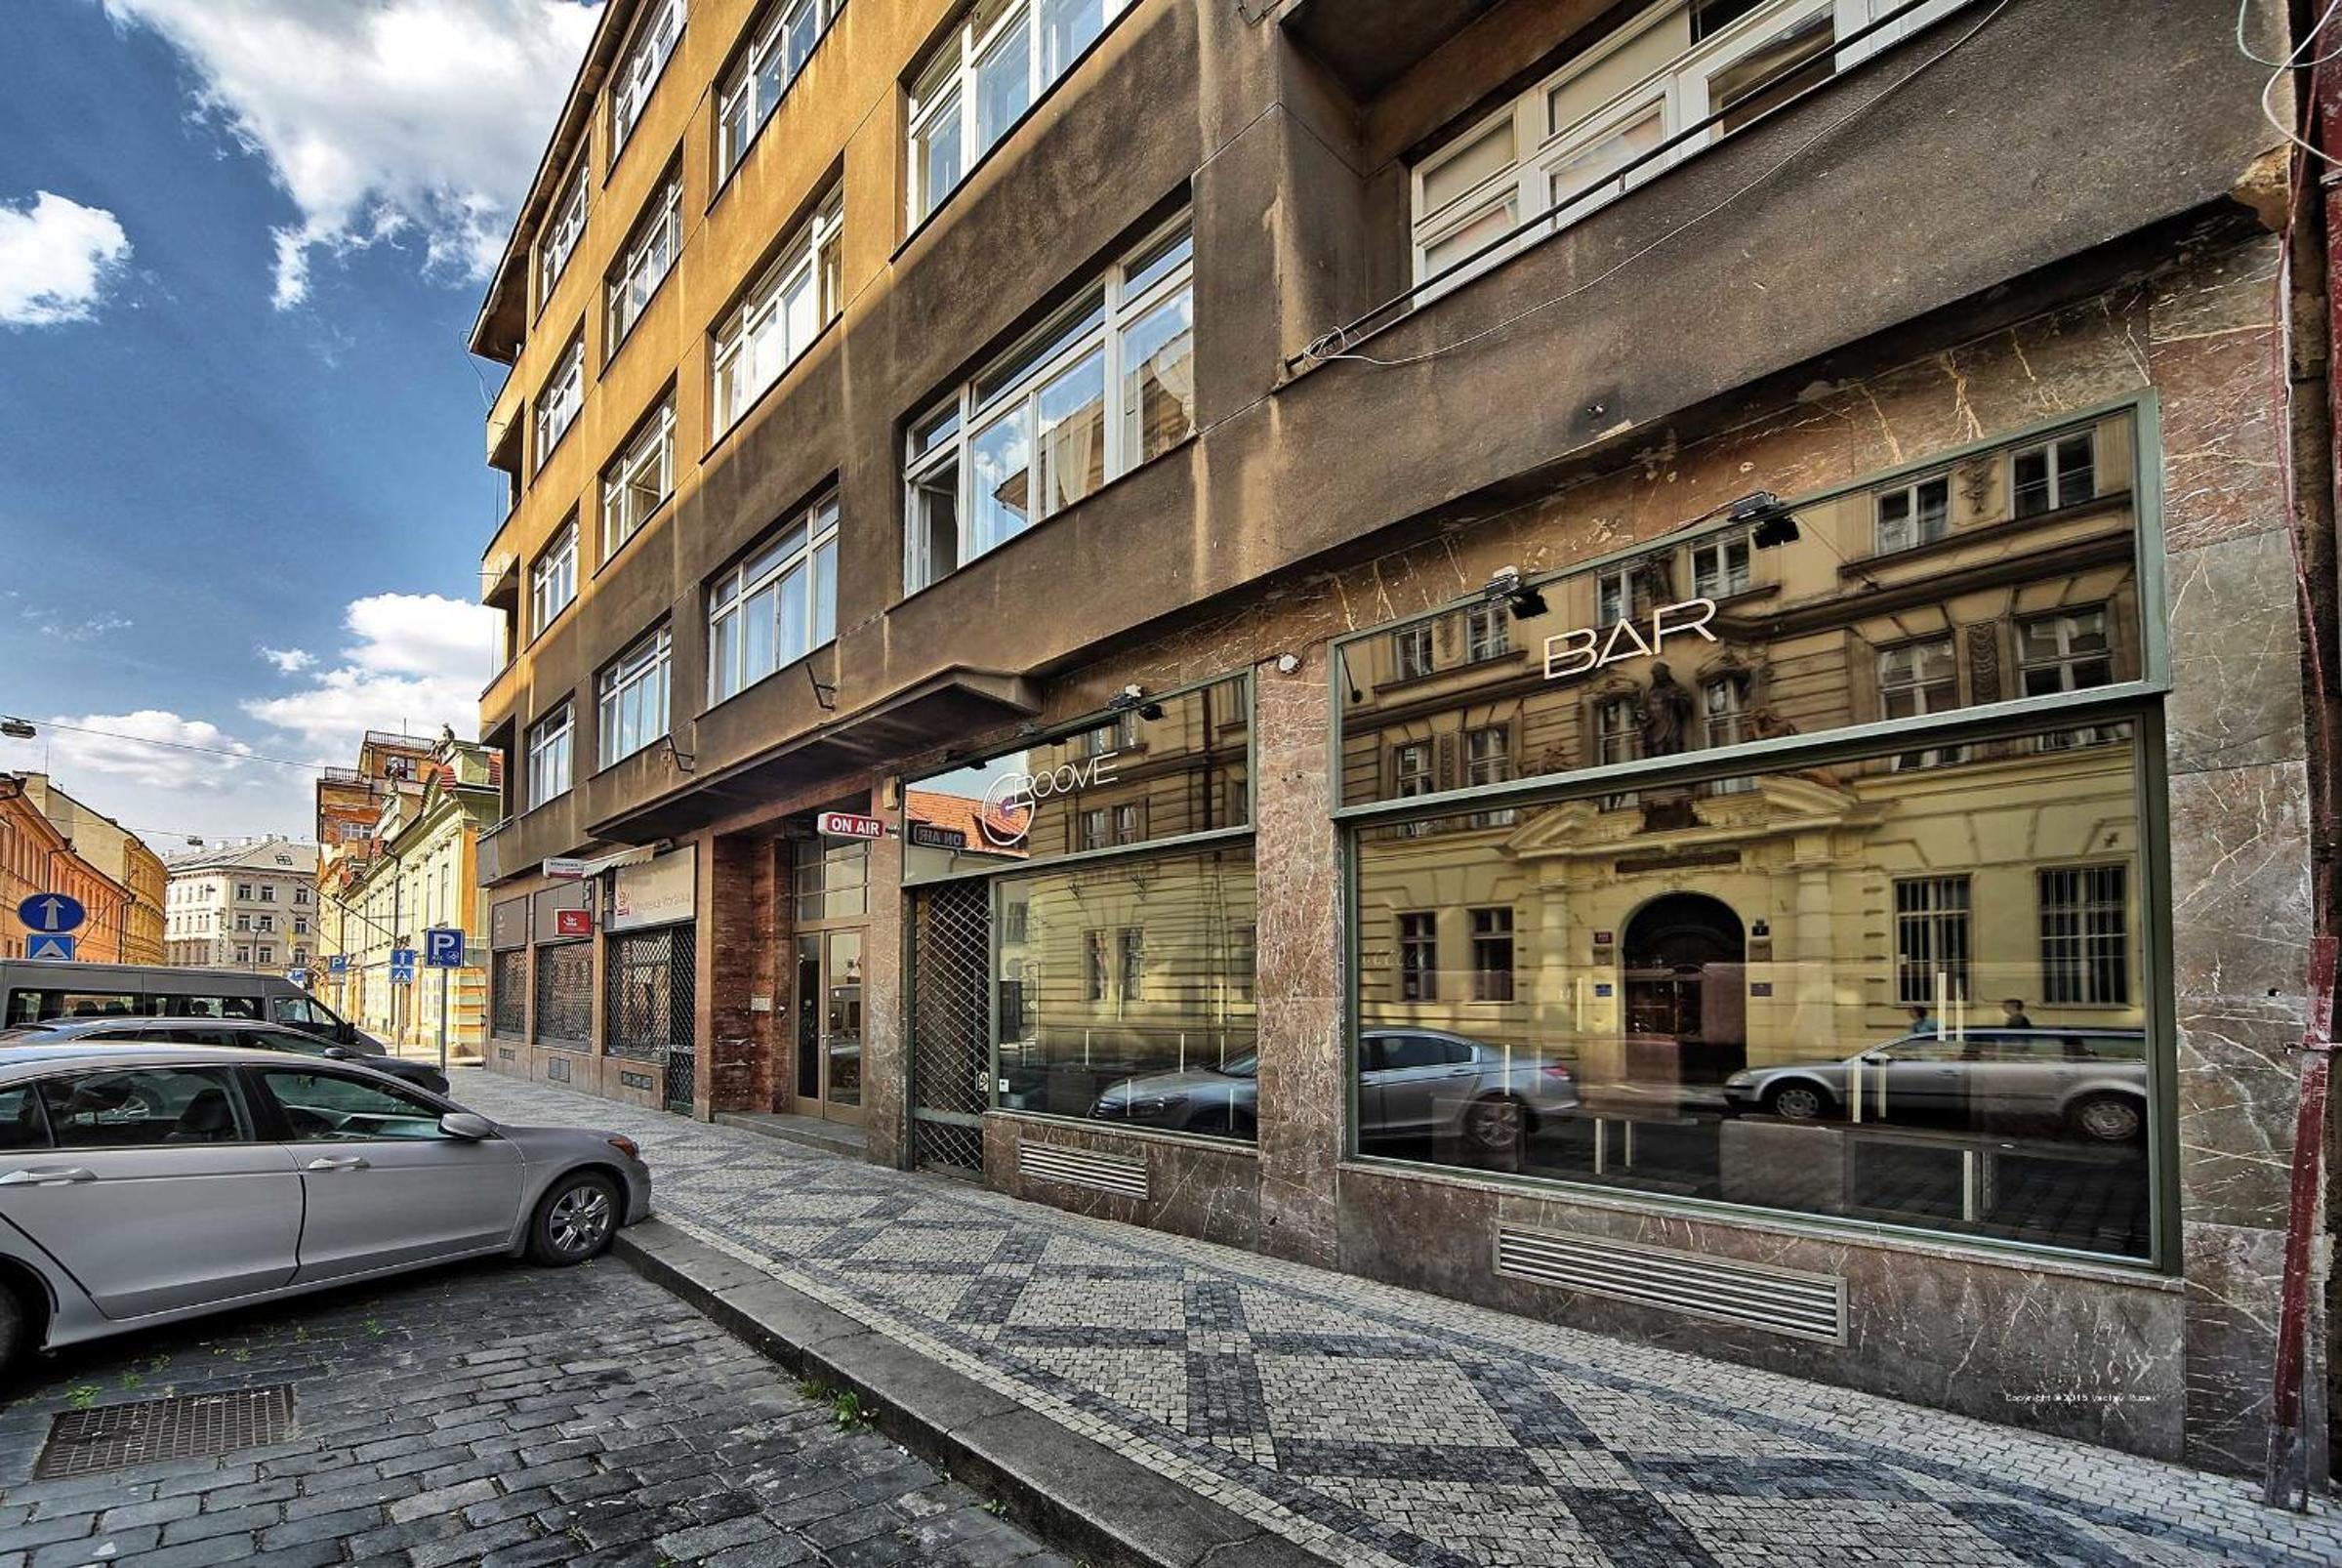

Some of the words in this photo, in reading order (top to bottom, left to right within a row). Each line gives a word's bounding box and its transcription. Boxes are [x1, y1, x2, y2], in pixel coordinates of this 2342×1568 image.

[1543, 598, 1717, 680] BAR
[981, 752, 1119, 846] GROOVE
[832, 817, 851, 833] ON
[856, 819, 880, 836] AIR
[433, 933, 455, 956] P
[332, 957, 343, 968] P
